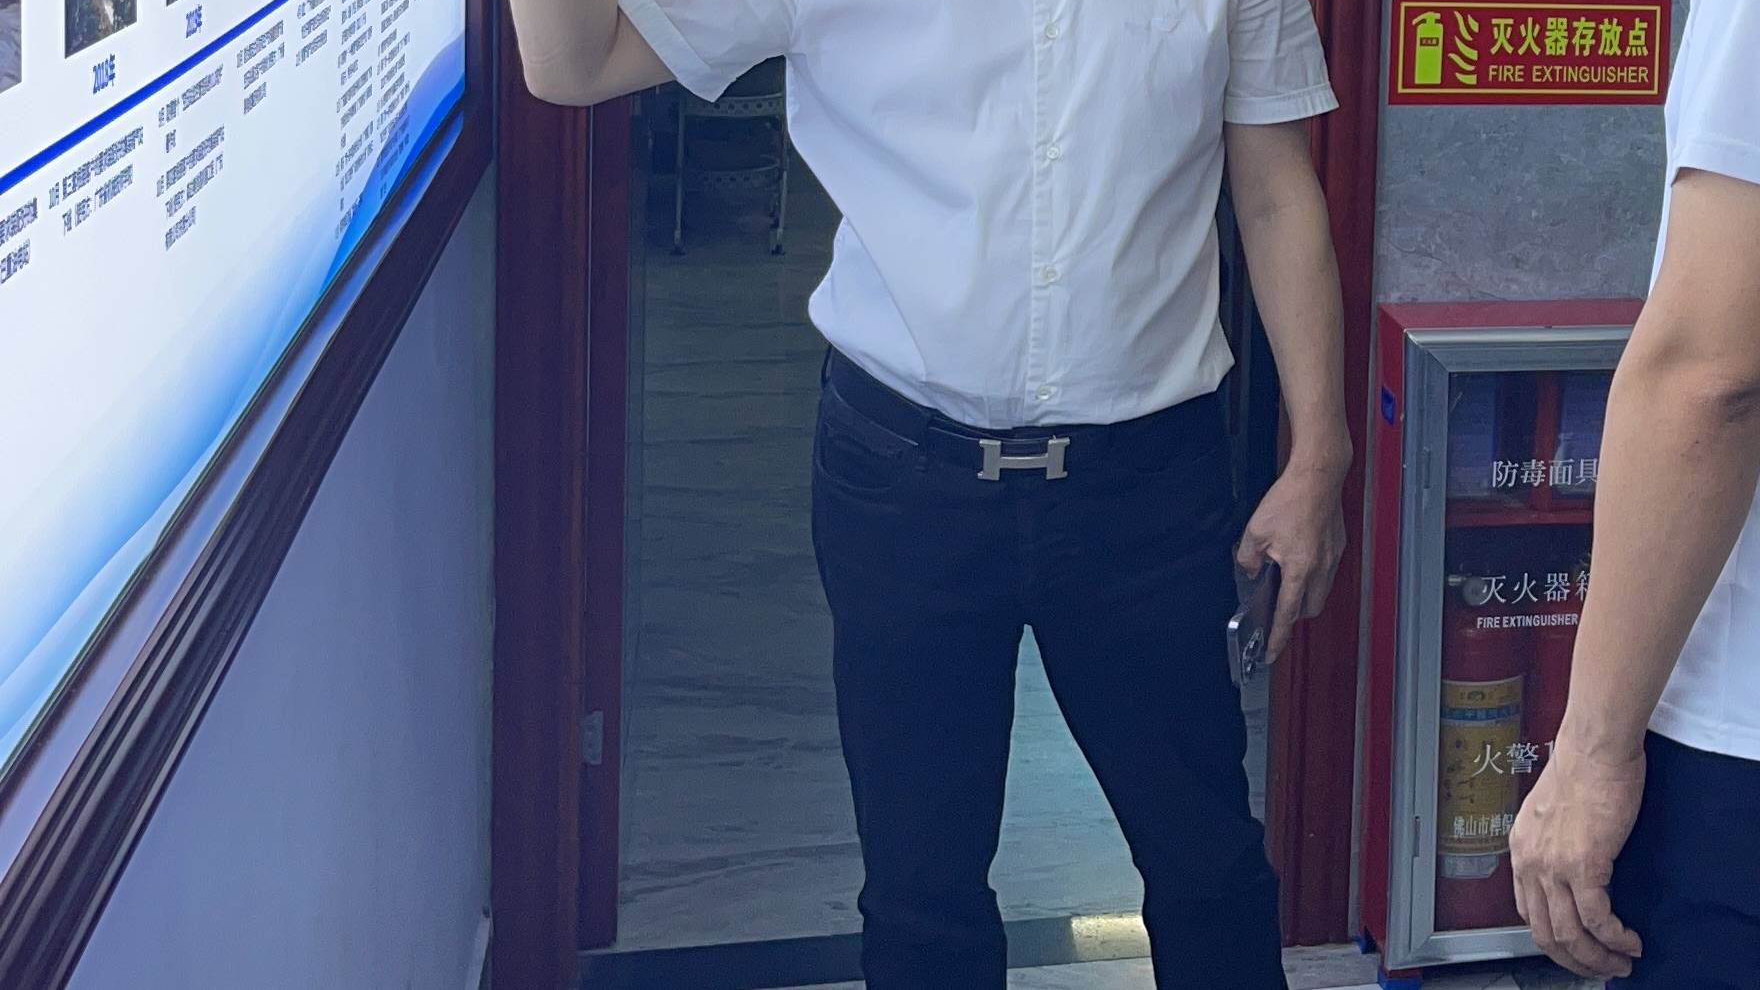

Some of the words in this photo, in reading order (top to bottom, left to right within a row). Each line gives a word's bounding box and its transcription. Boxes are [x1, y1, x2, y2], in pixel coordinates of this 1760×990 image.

[1489, 16, 1649, 57] 灭火器存放点
[1488, 65, 1525, 83] FIRE
[1532, 65, 1649, 83] EXTINGUISHER
[1492, 458, 1600, 488] 防毒面具
[1477, 616, 1500, 628] FIRE
[1502, 613, 1579, 628] EXTINGUISHER
